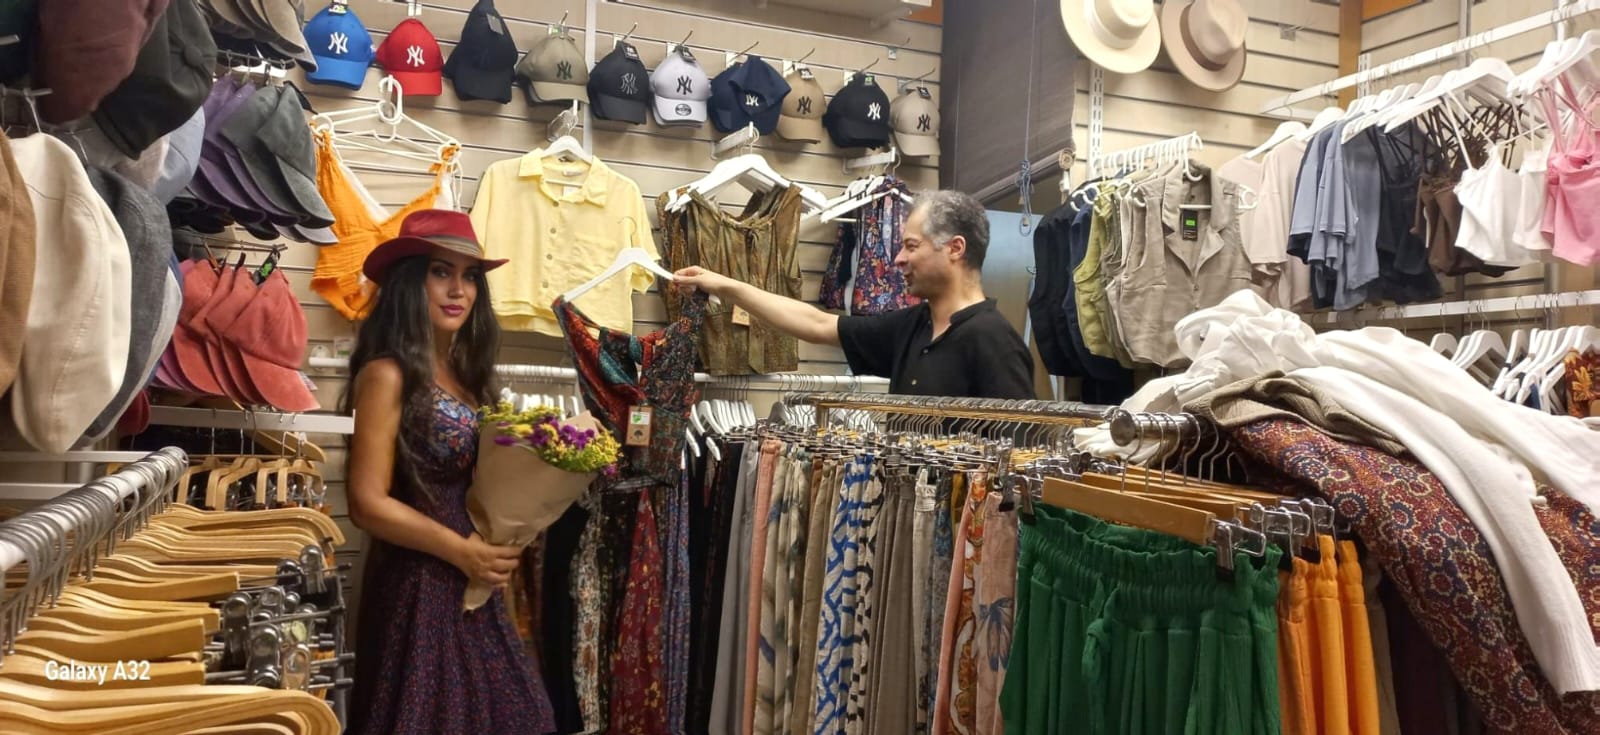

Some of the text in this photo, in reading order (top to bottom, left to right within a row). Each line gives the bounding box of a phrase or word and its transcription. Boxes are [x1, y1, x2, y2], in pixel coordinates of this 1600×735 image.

[328, 31, 348, 54] NY
[407, 45, 425, 67] NY
[556, 60, 572, 80] NY
[676, 75, 693, 95] NY
[797, 95, 812, 115] NY
[867, 101, 881, 120] NY
[917, 113, 931, 132] NY
